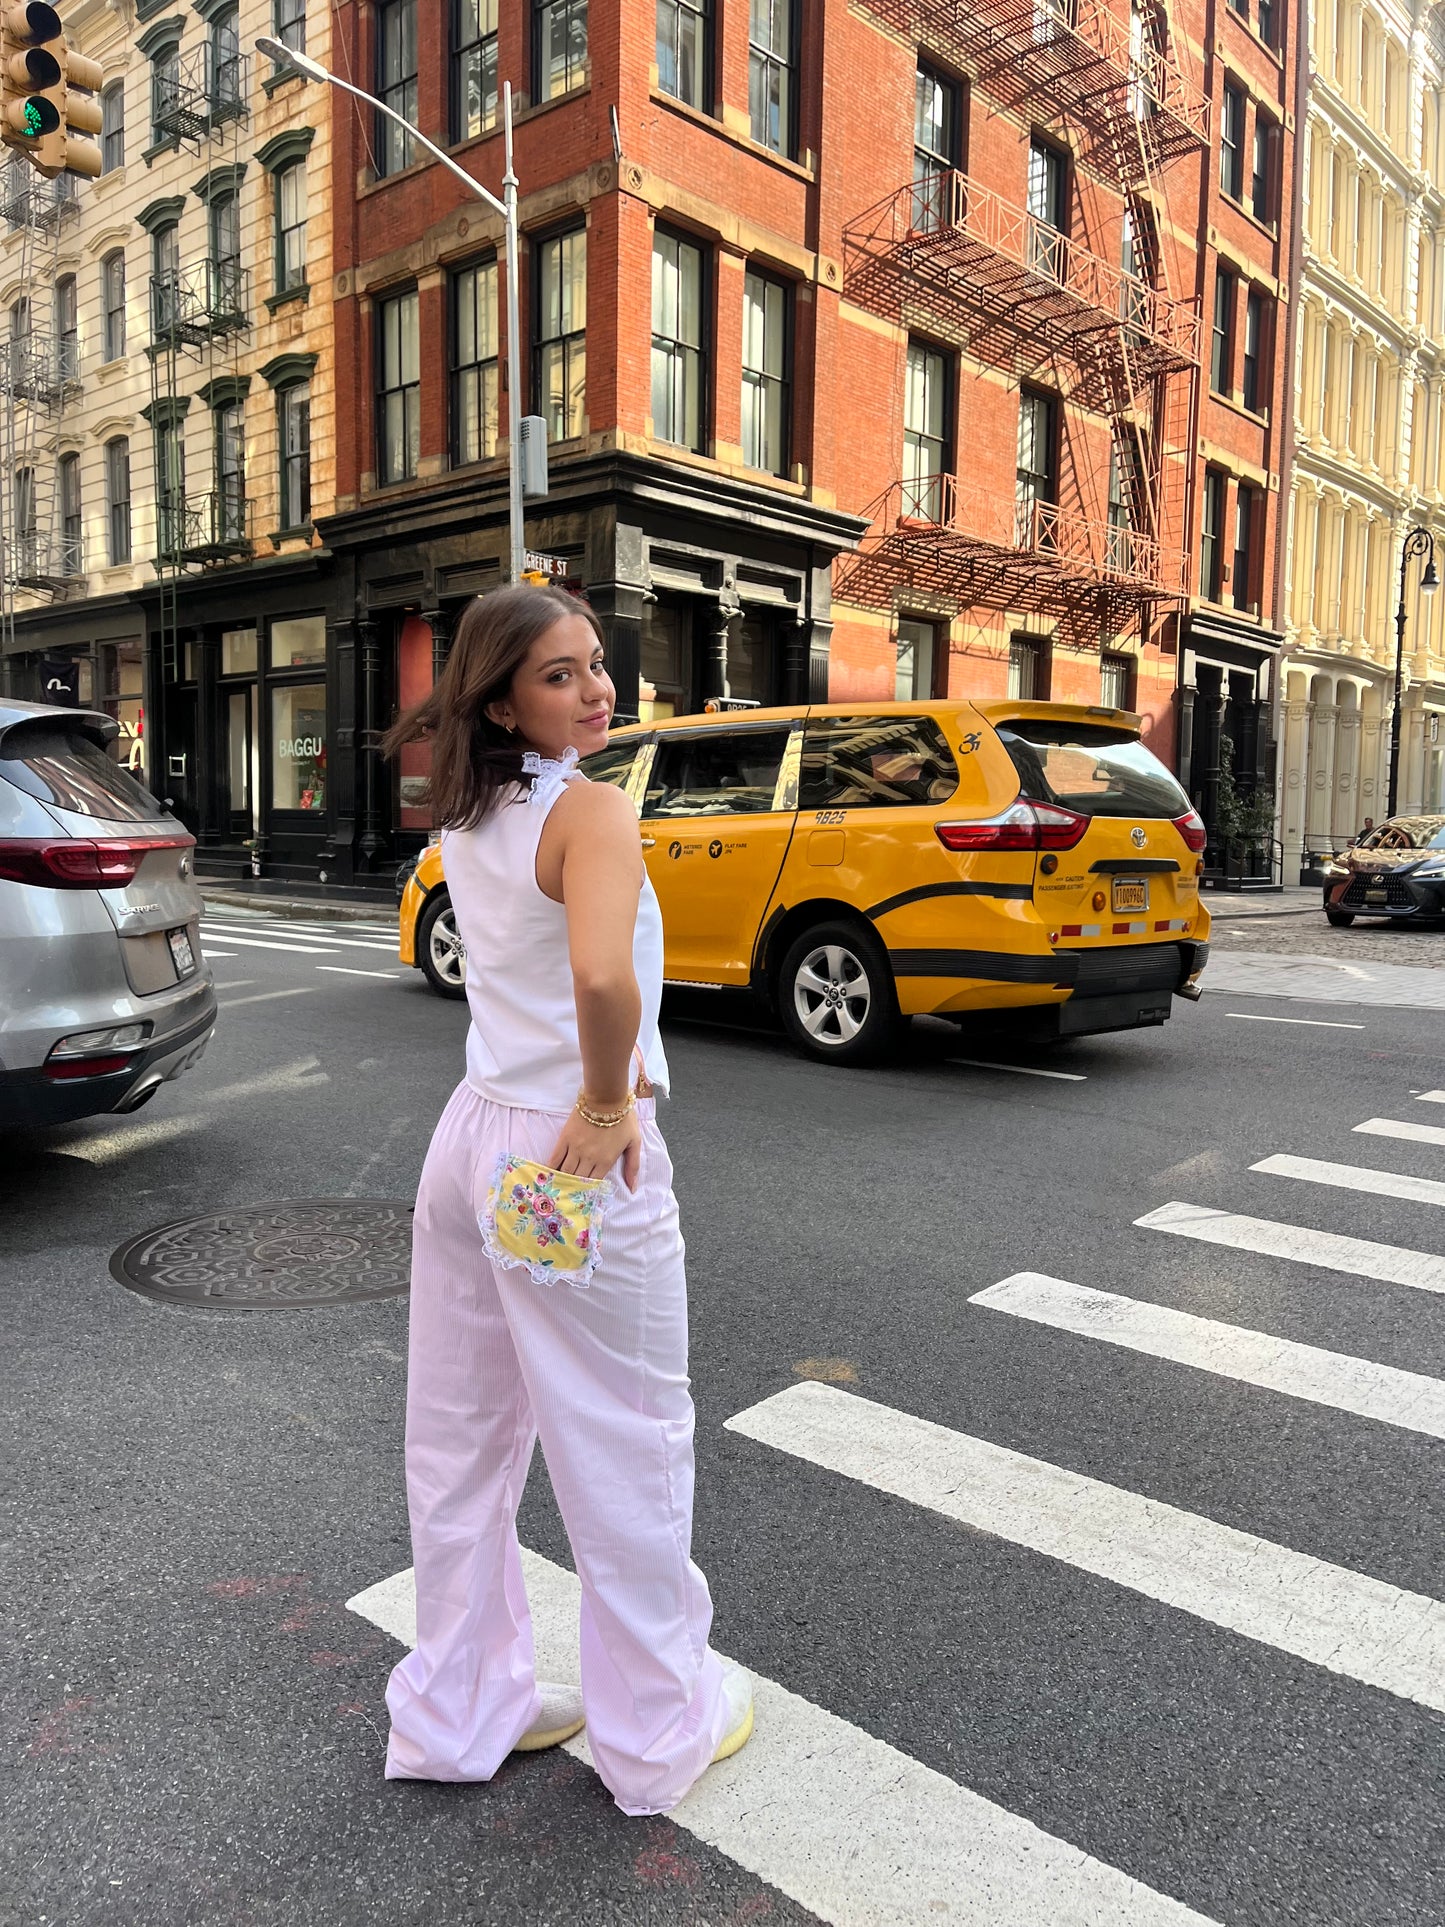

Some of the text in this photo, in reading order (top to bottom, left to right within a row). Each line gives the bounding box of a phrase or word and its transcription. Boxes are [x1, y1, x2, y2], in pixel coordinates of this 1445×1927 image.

[526, 553, 567, 576] GREENE ST
[279, 736, 322, 758] BAGGU
[815, 810, 847, 824] 9B25
